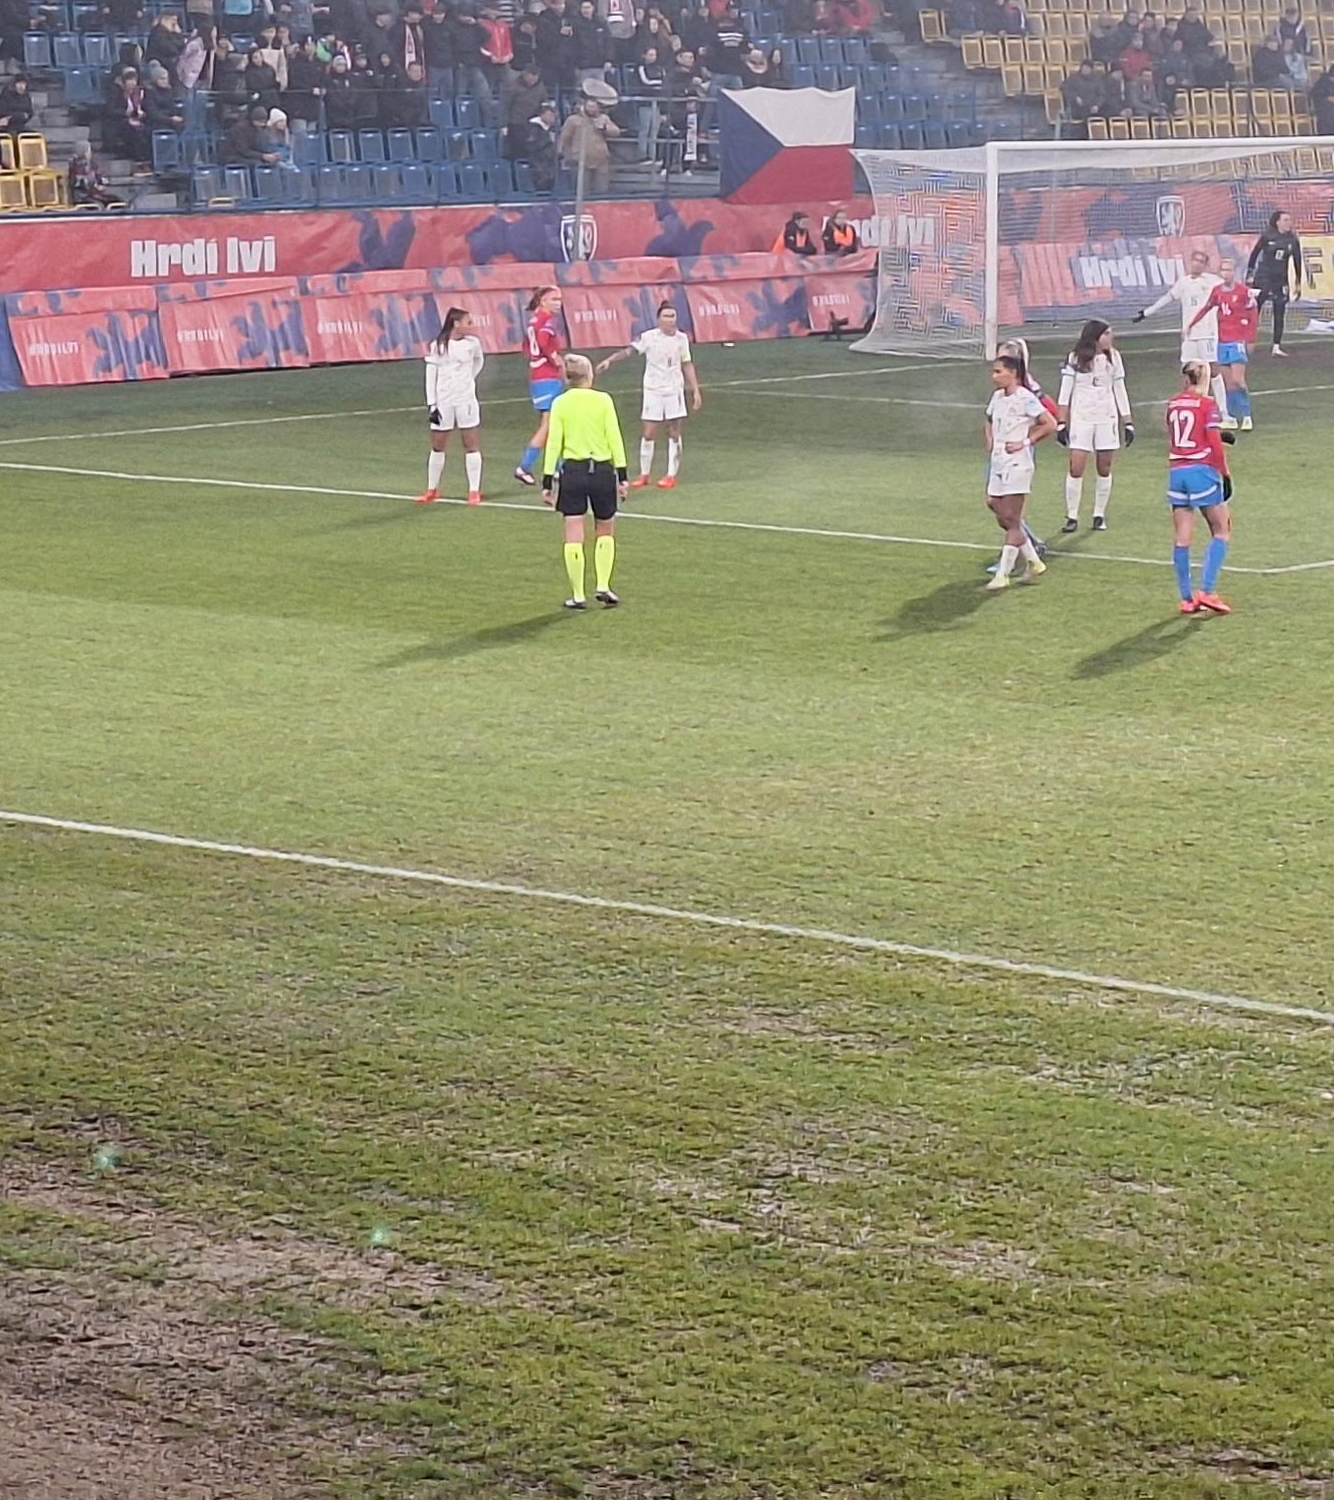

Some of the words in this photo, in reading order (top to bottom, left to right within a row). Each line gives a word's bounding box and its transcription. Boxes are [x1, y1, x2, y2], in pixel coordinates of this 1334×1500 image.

[131, 237, 218, 277] Hrdí
[226, 236, 276, 274] lvi
[1169, 409, 1197, 448] 12
